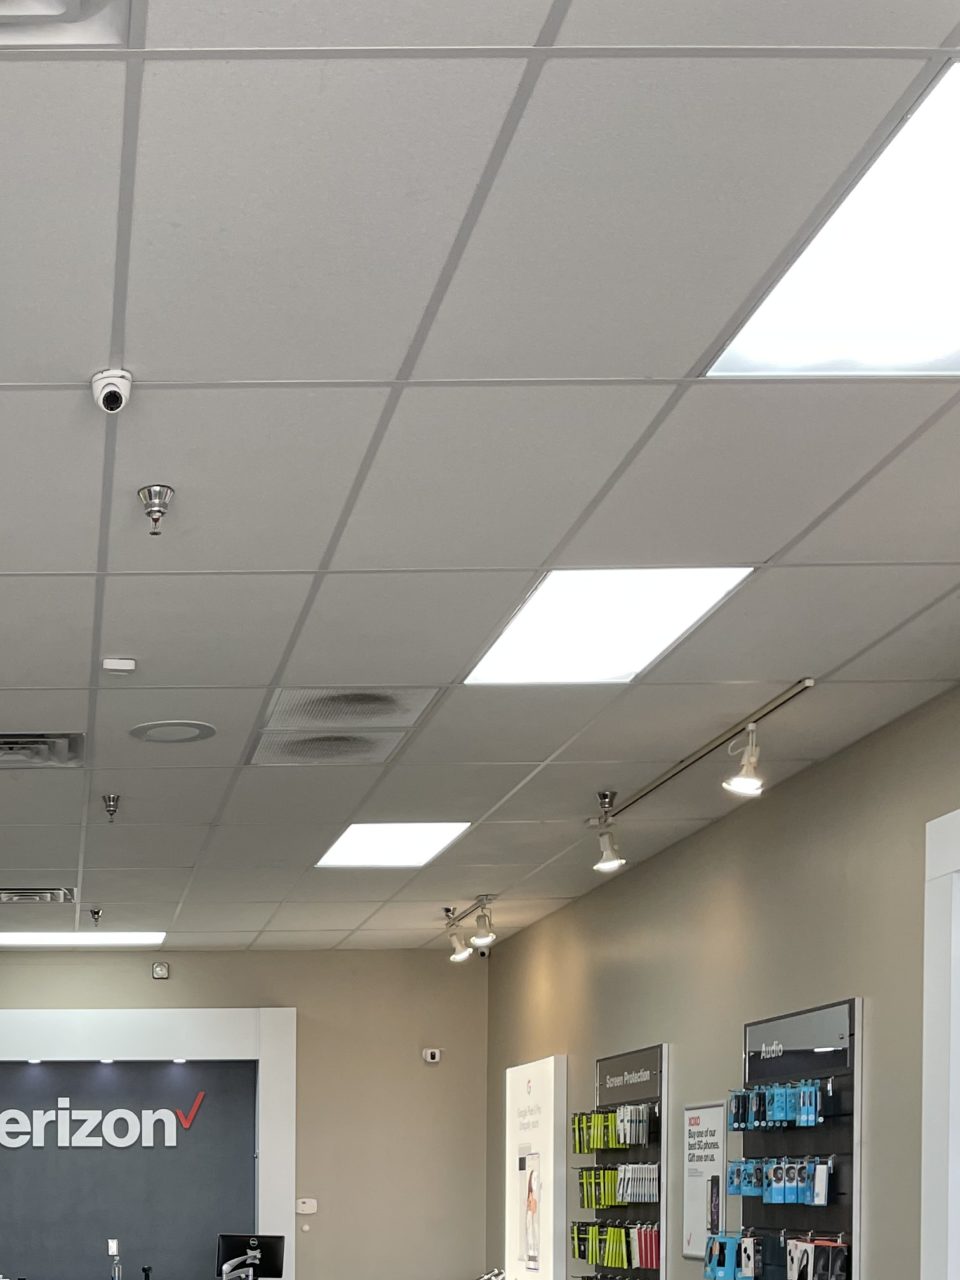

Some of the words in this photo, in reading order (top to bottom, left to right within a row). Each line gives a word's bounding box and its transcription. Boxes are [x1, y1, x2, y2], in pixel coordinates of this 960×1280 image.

[760, 1041, 784, 1060] Audio
[606, 1075, 623, 1089] Screen
[624, 1068, 650, 1085] Protection
[688, 1129, 696, 1140] Buy
[696, 1130, 704, 1138] one
[704, 1128, 709, 1138] of
[688, 1141, 696, 1150] best
[697, 1140, 703, 1150] 5G
[688, 1153, 696, 1162] Gift
